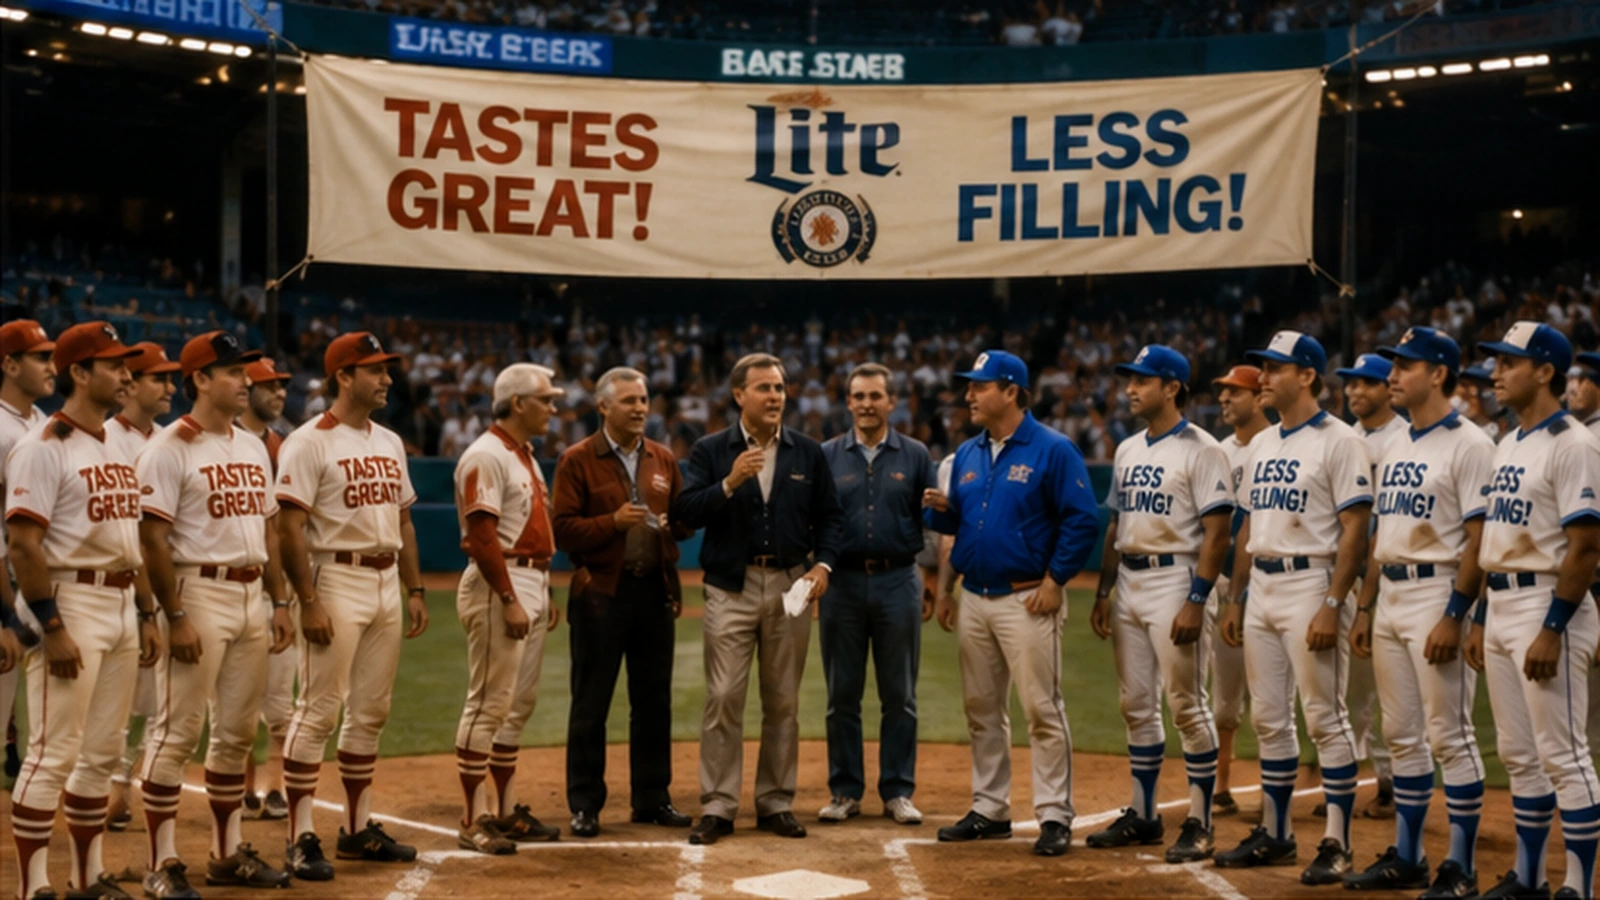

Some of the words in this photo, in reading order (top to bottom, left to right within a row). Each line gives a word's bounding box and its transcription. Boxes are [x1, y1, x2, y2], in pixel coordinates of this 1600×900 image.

[384, 97, 659, 171] TASTES
[745, 103, 901, 194] Lite
[1010, 109, 1190, 172] LESS
[386, 168, 654, 242] GREAT!
[957, 173, 1247, 242] FILLING!
[199, 463, 266, 491] TASTES
[337, 456, 402, 481] TASTES
[1121, 465, 1165, 488] LESS
[1253, 458, 1301, 484] LESS
[1381, 461, 1428, 488] LESS
